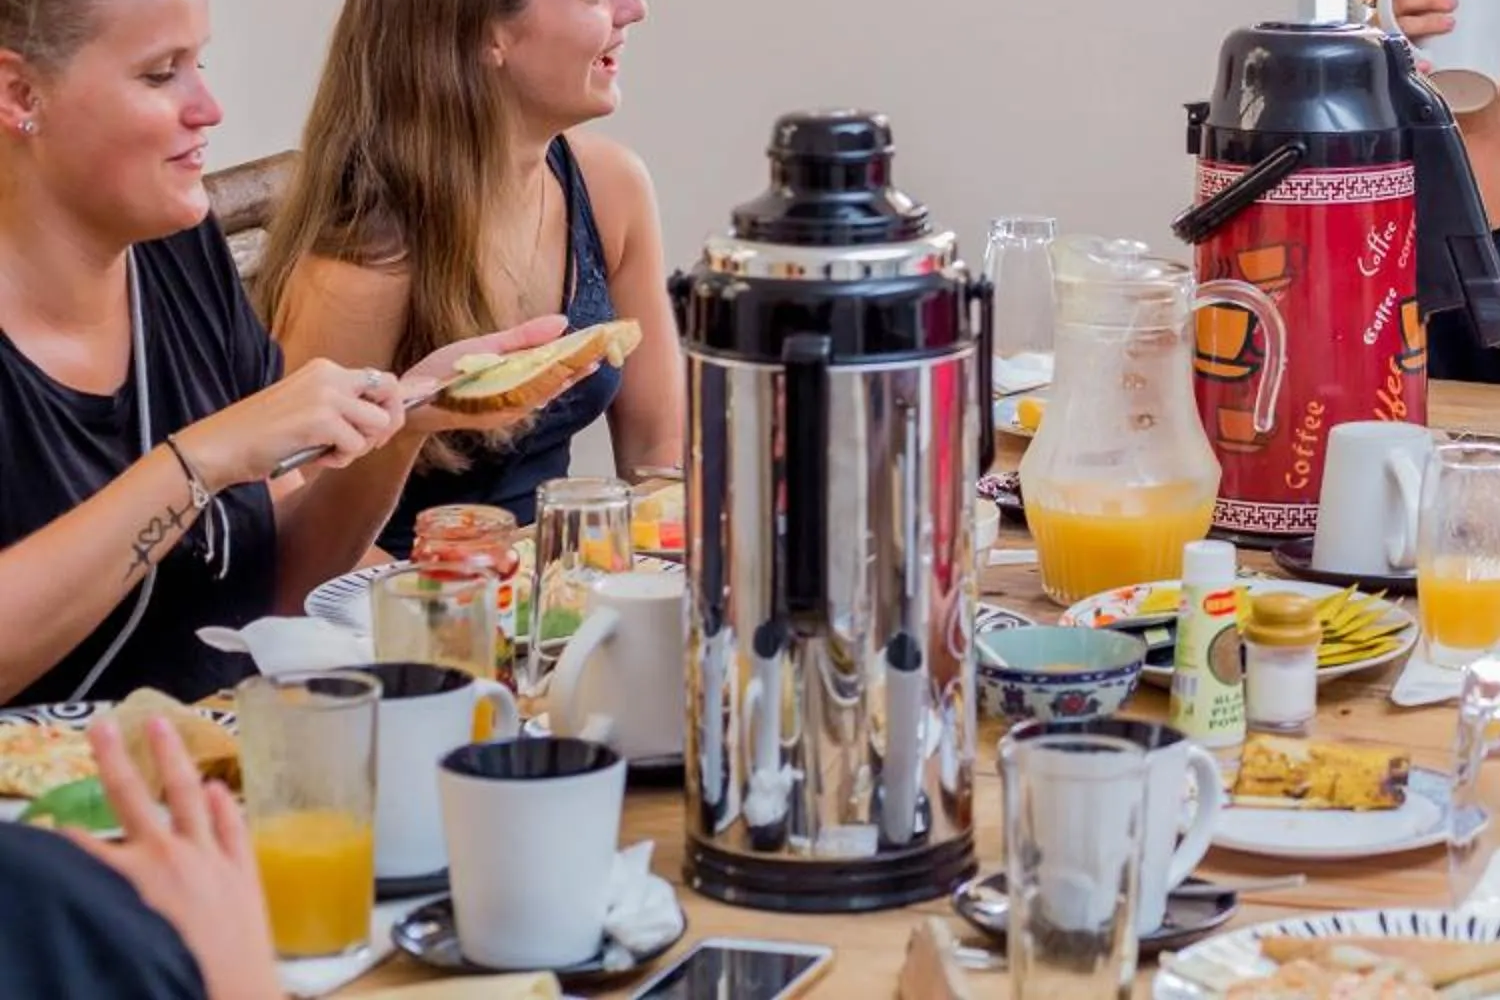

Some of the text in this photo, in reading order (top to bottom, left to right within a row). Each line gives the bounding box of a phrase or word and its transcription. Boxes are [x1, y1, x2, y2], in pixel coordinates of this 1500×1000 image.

[1357, 221, 1397, 277] Coffee
[1363, 287, 1397, 345] Coffee
[1285, 401, 1325, 489] Coffee
